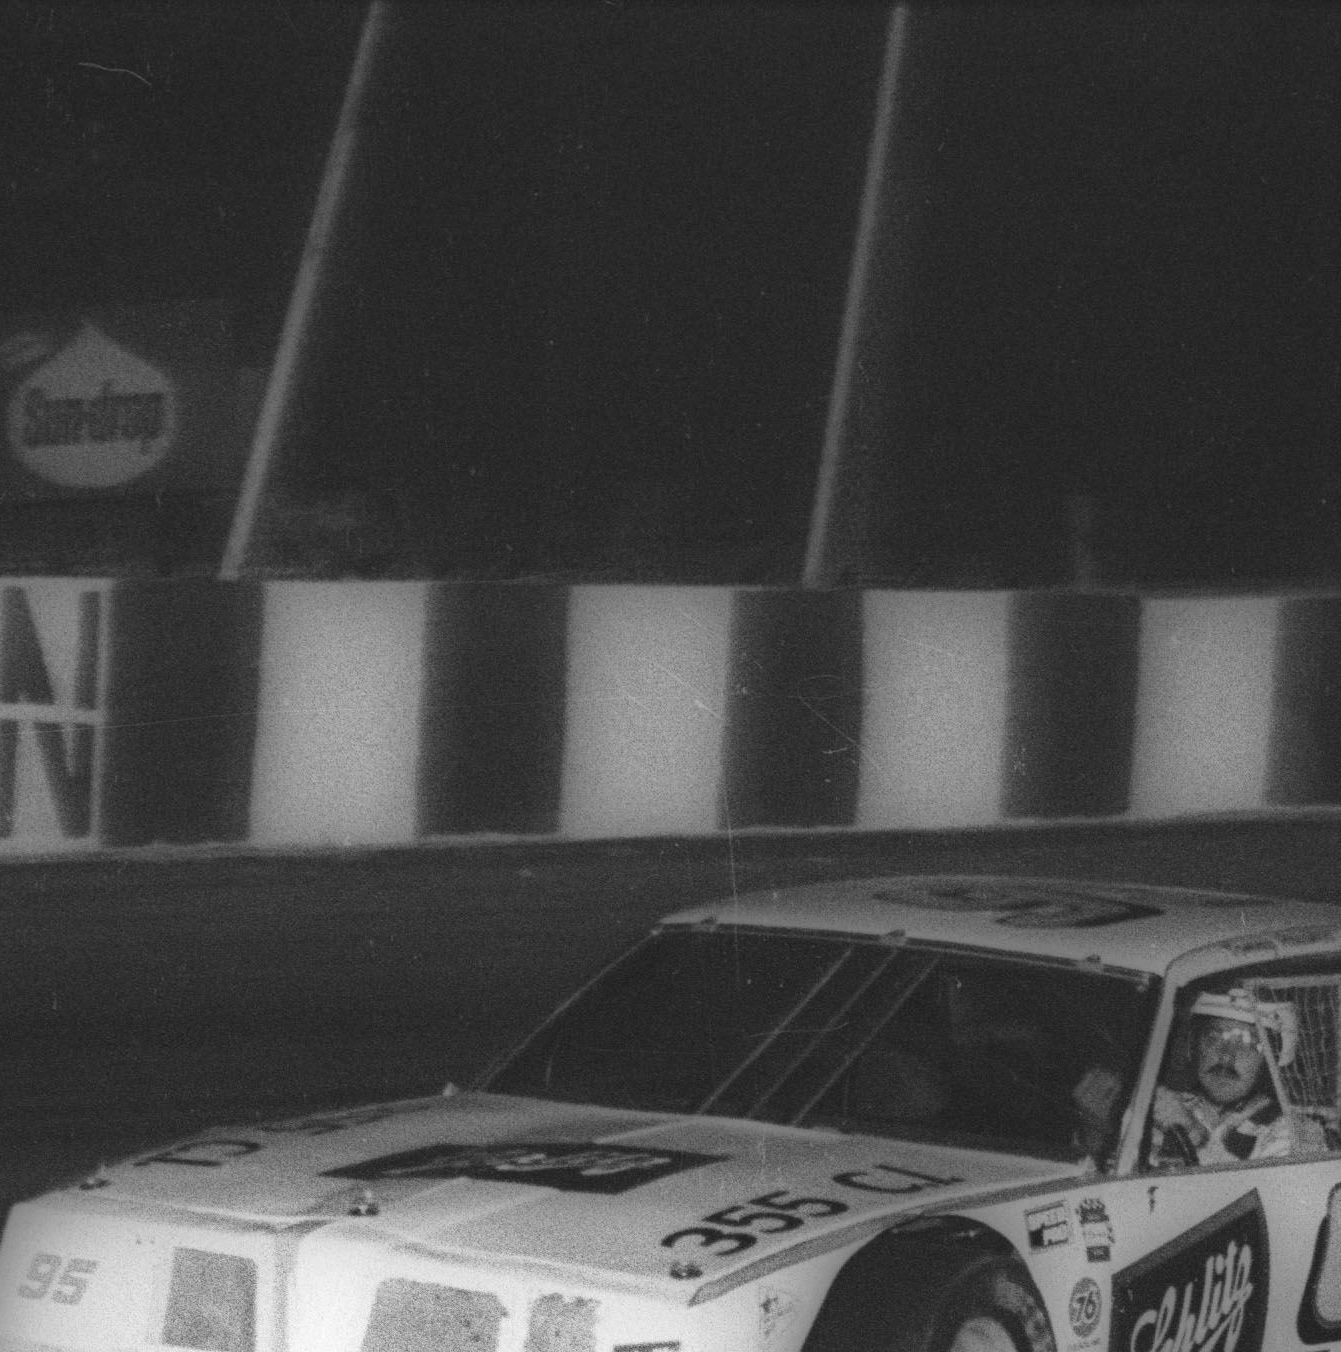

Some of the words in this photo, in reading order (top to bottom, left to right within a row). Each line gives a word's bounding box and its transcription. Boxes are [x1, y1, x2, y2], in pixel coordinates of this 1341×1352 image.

[661, 1189, 849, 1257] 355
[16, 1251, 98, 1306] 95
[1073, 1288, 1098, 1321] 76
